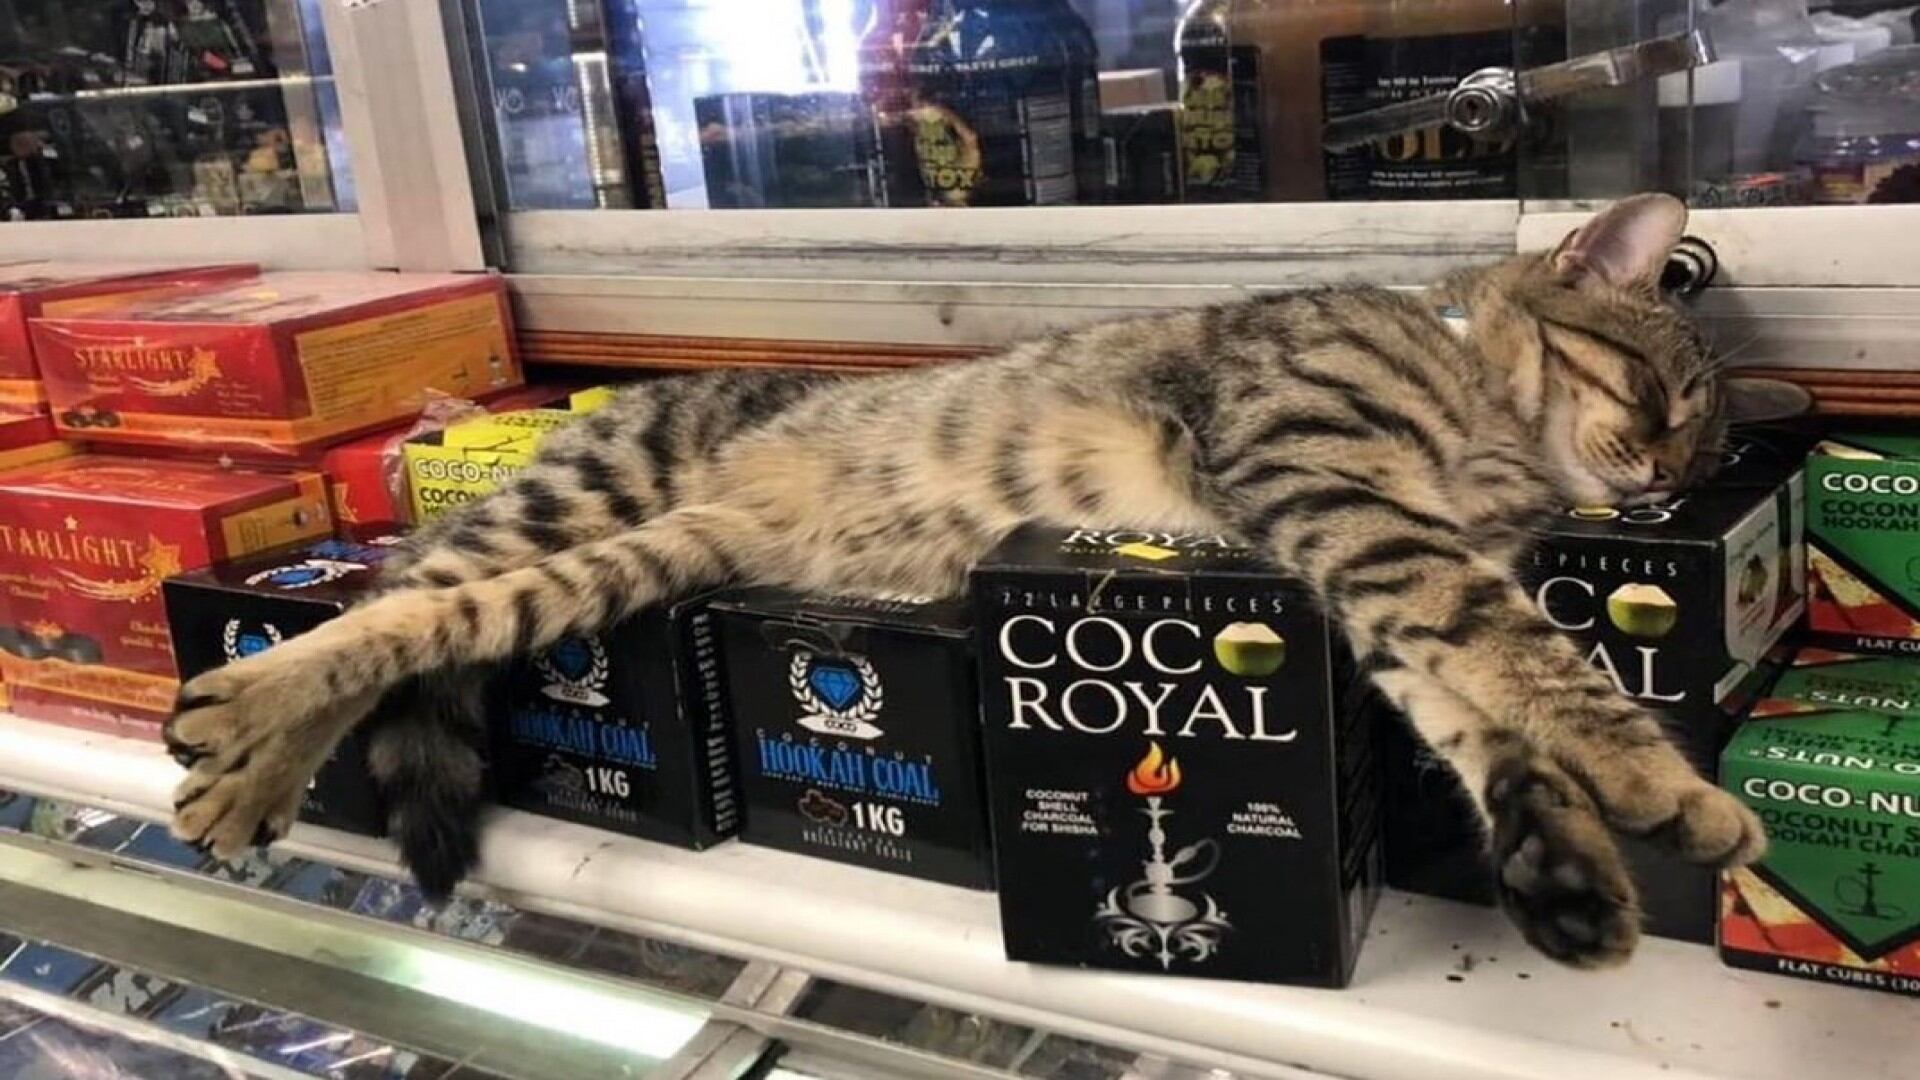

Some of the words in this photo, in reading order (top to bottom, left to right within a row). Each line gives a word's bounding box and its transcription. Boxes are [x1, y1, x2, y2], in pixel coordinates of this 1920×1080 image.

[73, 347, 187, 371] STARLIGHT
[1062, 530, 1254, 548] ROYA
[1559, 553, 1678, 577] PIECES
[1003, 676, 1297, 742] ROYAL
[757, 738, 866, 789] HOOKAH
[871, 757, 938, 801] COAL
[1025, 788, 1090, 803] COCONUT
[1037, 800, 1079, 814] SHELL
[1246, 801, 1281, 815] 100%
[1022, 808, 1094, 825] CHARCOAL
[1230, 811, 1297, 828] NATURAL
[1759, 807, 1894, 839] OCONUT
[1021, 819, 1048, 833] FOR
[1051, 822, 1099, 836] SHISHA
[1226, 823, 1303, 840] CHARCOAL
[1777, 958, 1821, 976] FLAT
[1825, 966, 1888, 987] CUBES
